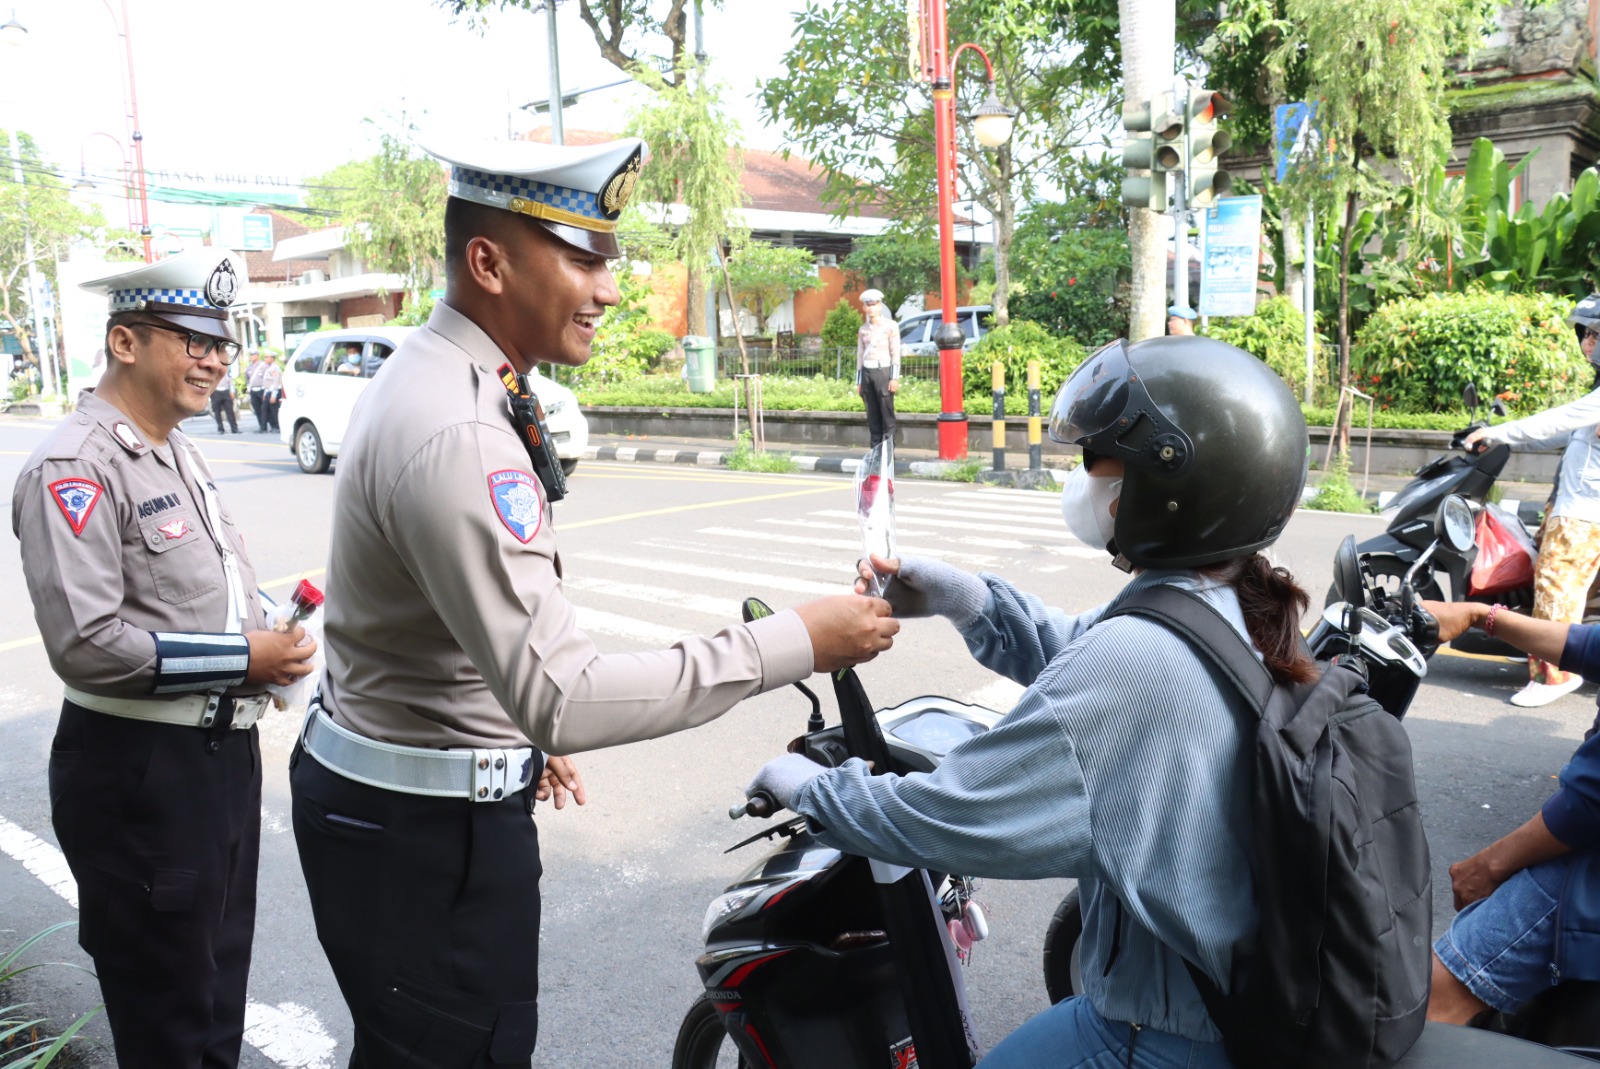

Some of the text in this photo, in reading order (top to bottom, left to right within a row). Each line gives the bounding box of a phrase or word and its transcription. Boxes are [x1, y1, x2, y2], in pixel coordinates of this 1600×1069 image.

[159, 169, 206, 183] BANK
[254, 174, 290, 187] BALI
[491, 472, 513, 485] LALU
[137, 496, 169, 519] AGUNG
[707, 990, 743, 1000] HONDA
